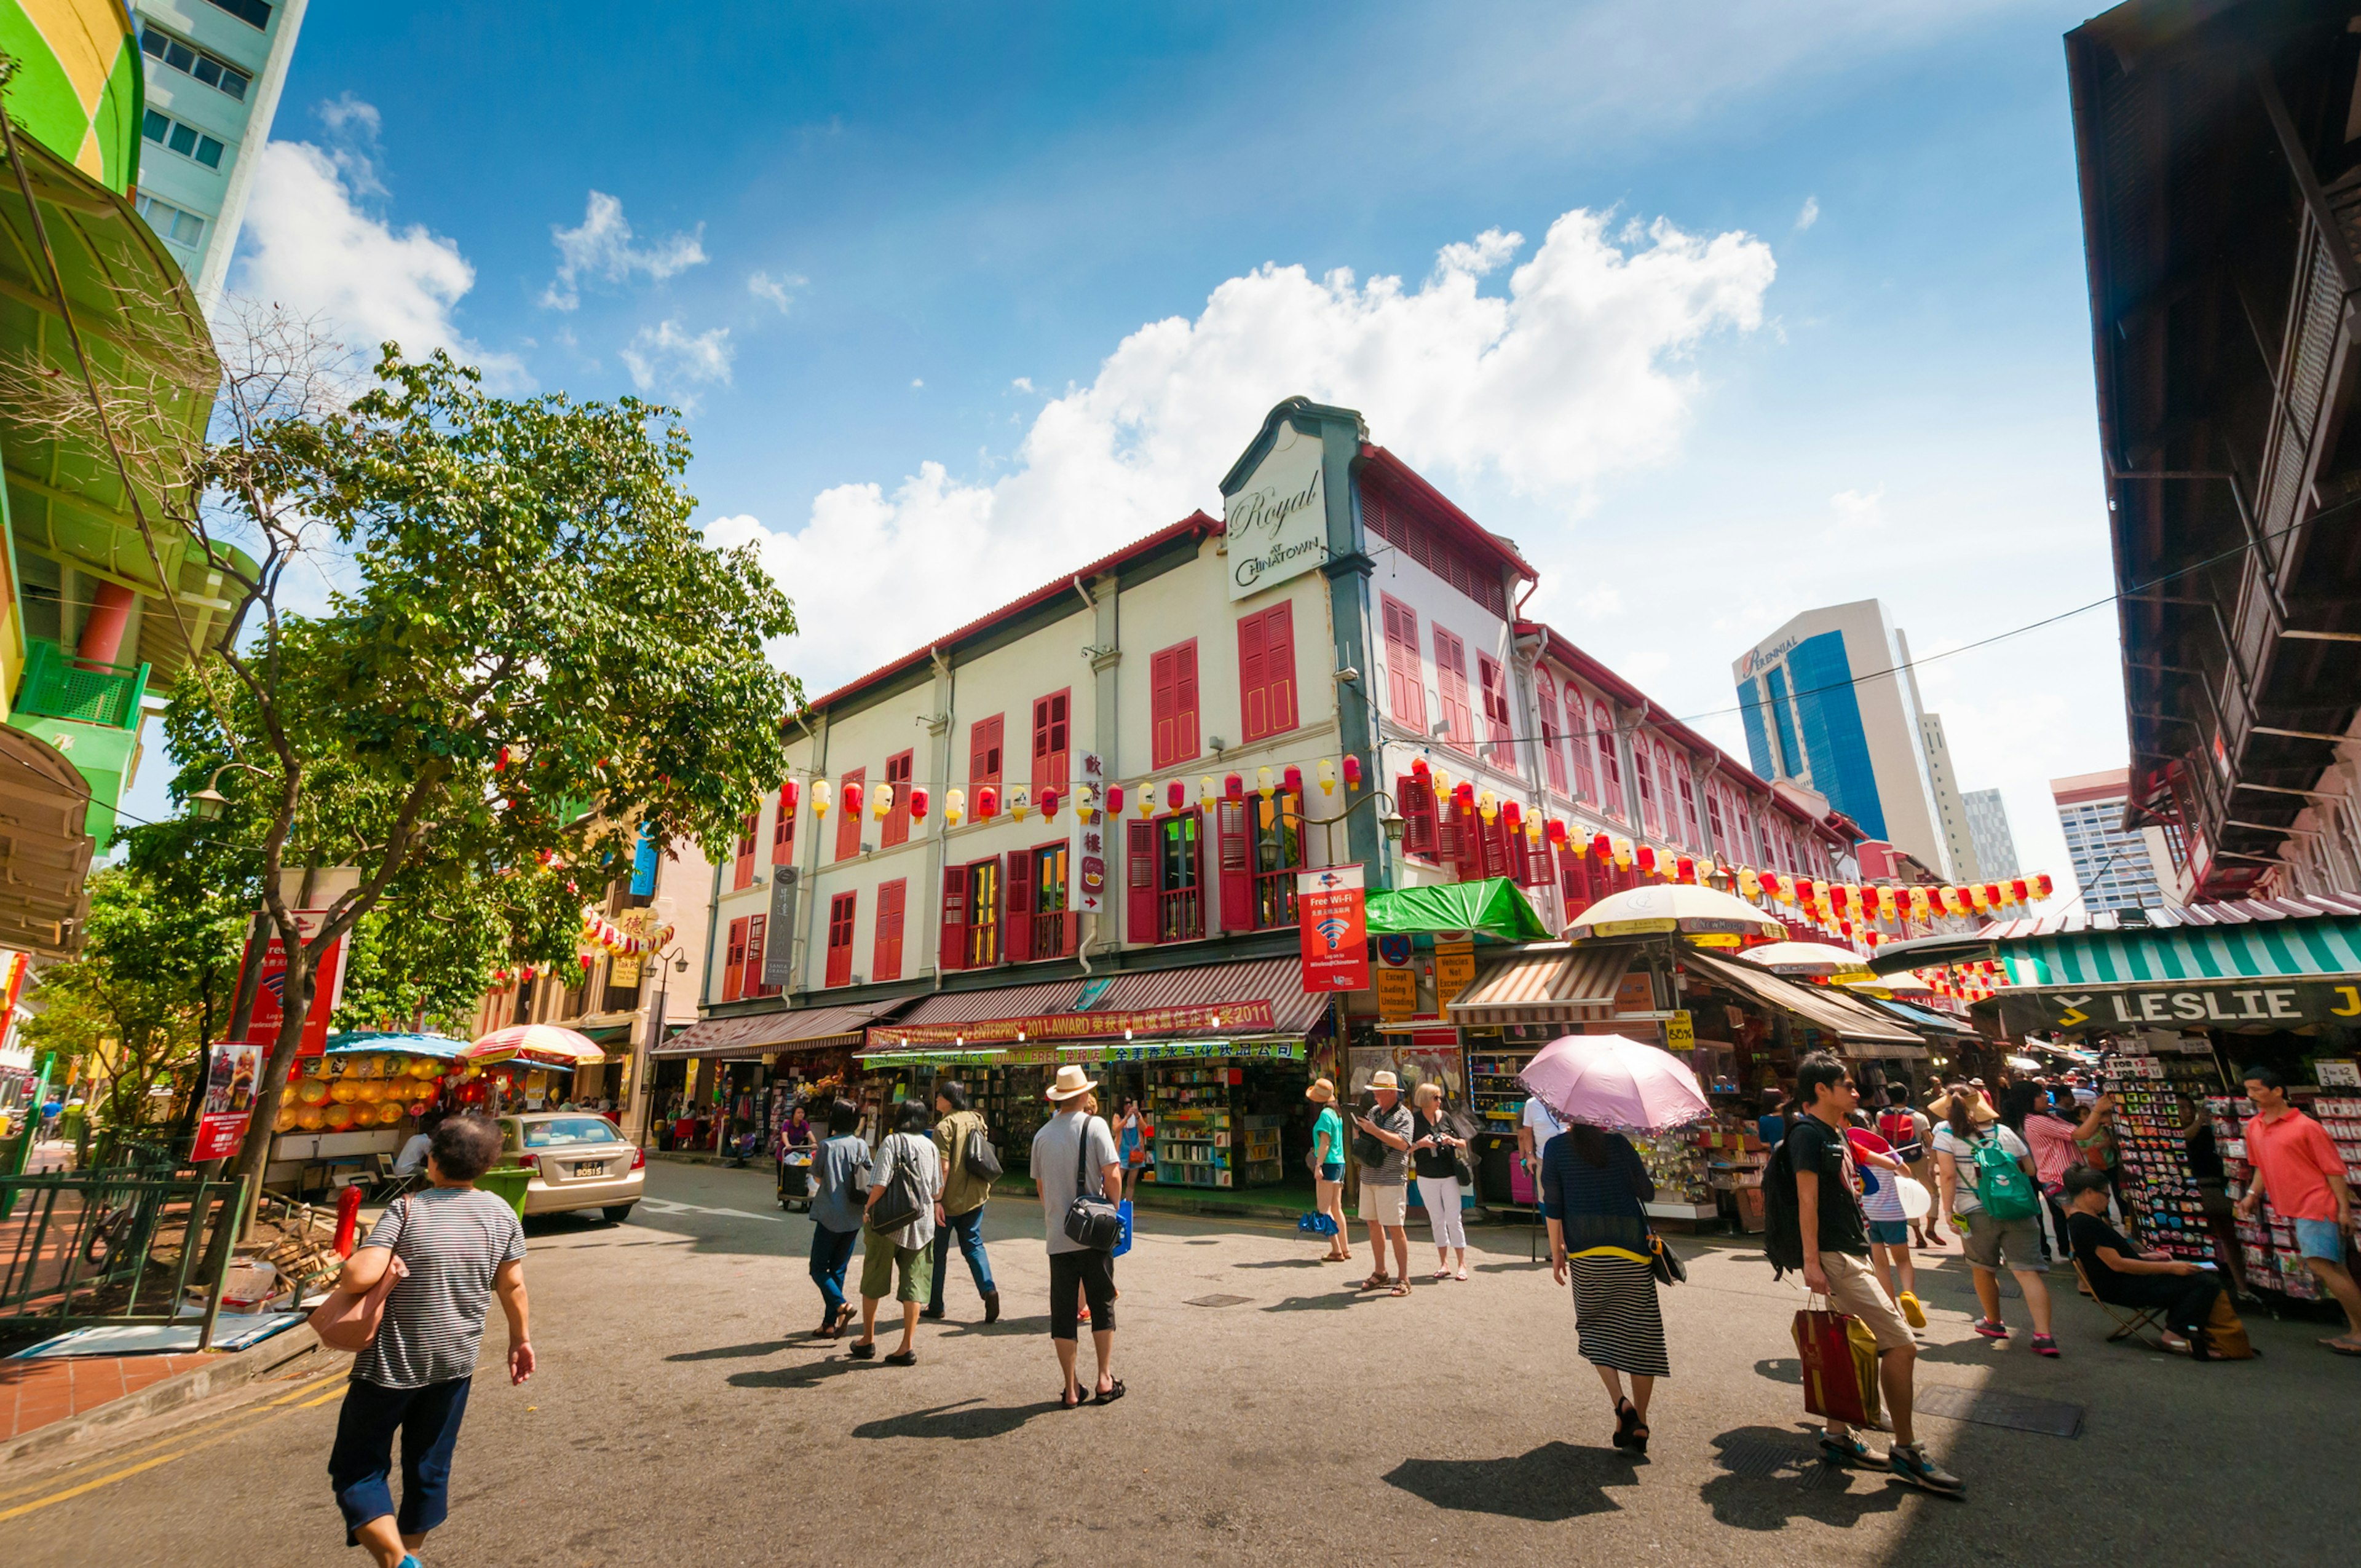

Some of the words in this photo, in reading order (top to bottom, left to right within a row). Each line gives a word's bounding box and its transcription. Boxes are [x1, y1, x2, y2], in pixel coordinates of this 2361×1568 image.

[1229, 470, 1319, 540] Royal
[1270, 543, 1283, 554] AT
[1235, 537, 1318, 586] CHINATOWN
[1742, 636, 1798, 678] PERENNIAL
[1310, 897, 1328, 906] Free
[1330, 894, 1352, 904] Wi-Fi
[1442, 958, 1469, 966] Vehicles
[1385, 972, 1407, 982] Except
[1439, 979, 1470, 988] Exceedin
[1380, 985, 1406, 995] Loading
[1381, 997, 1414, 1007] Unloading
[2111, 989, 2302, 1022] LESLIE
[1026, 1019, 1050, 1037] 2011
[1052, 1017, 1089, 1035] AWARD
[1031, 1051, 1059, 1063] FREE
[2323, 1076, 2331, 1085] 3
